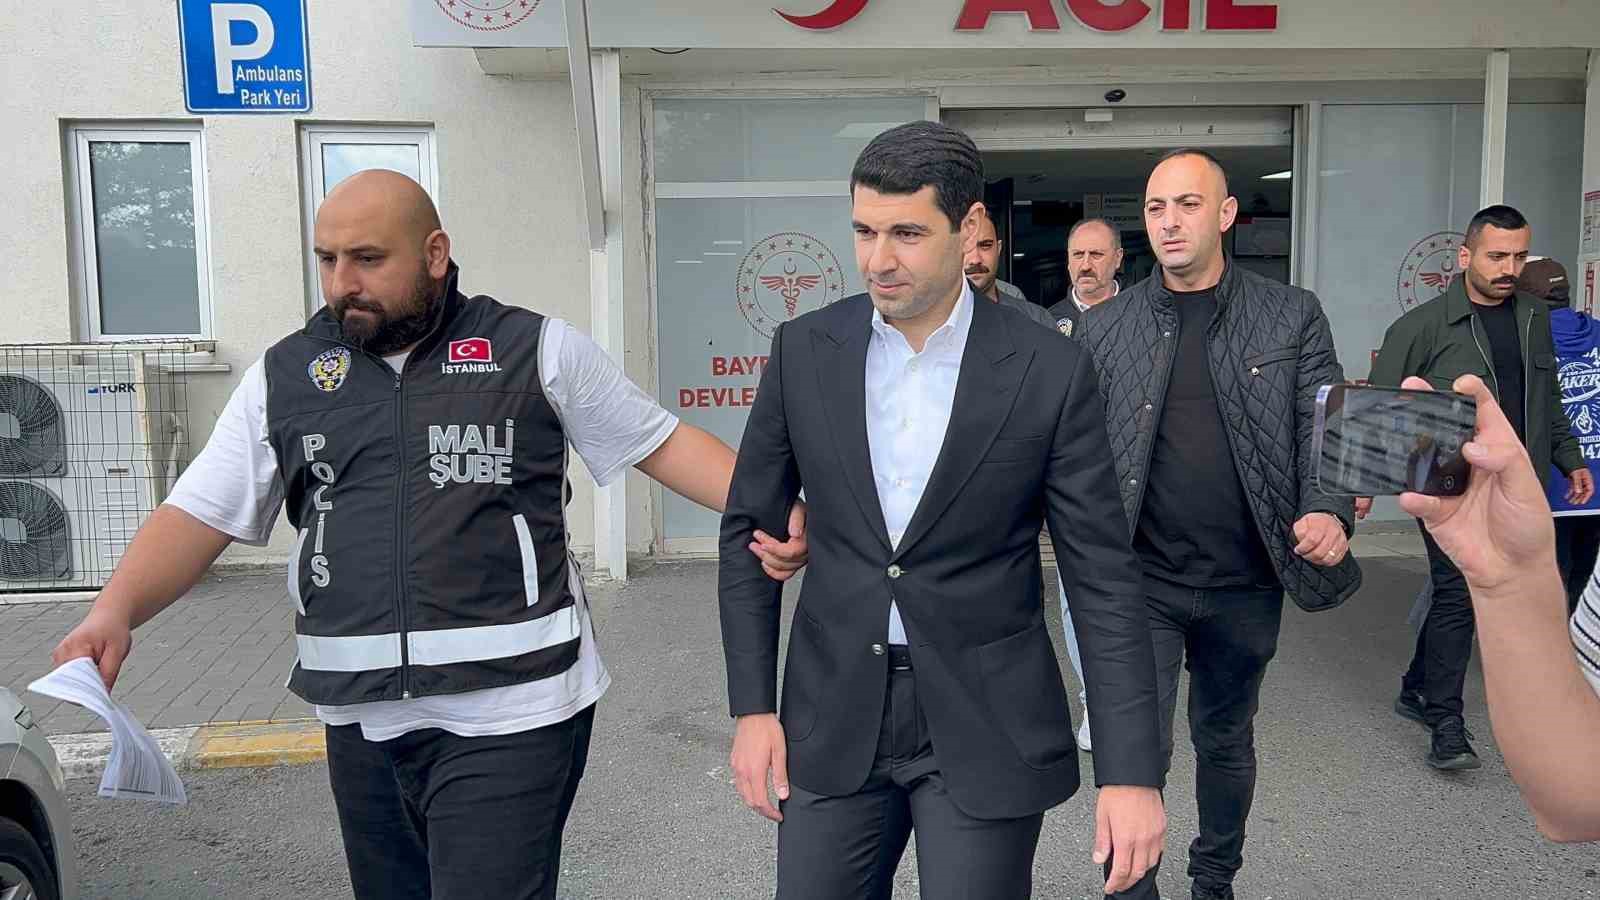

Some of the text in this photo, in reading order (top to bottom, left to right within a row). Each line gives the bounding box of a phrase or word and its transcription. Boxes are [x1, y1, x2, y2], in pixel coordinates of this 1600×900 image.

[210, 3, 275, 94] P
[236, 65, 303, 82] Ambulans
[241, 89, 301, 105] Park Yeri
[441, 362, 502, 374] İSTANBUL
[679, 387, 758, 408] DEVLE
[428, 418, 515, 456] MALİ
[428, 454, 514, 489] ŞUBE
[302, 433, 335, 588] POLİS
